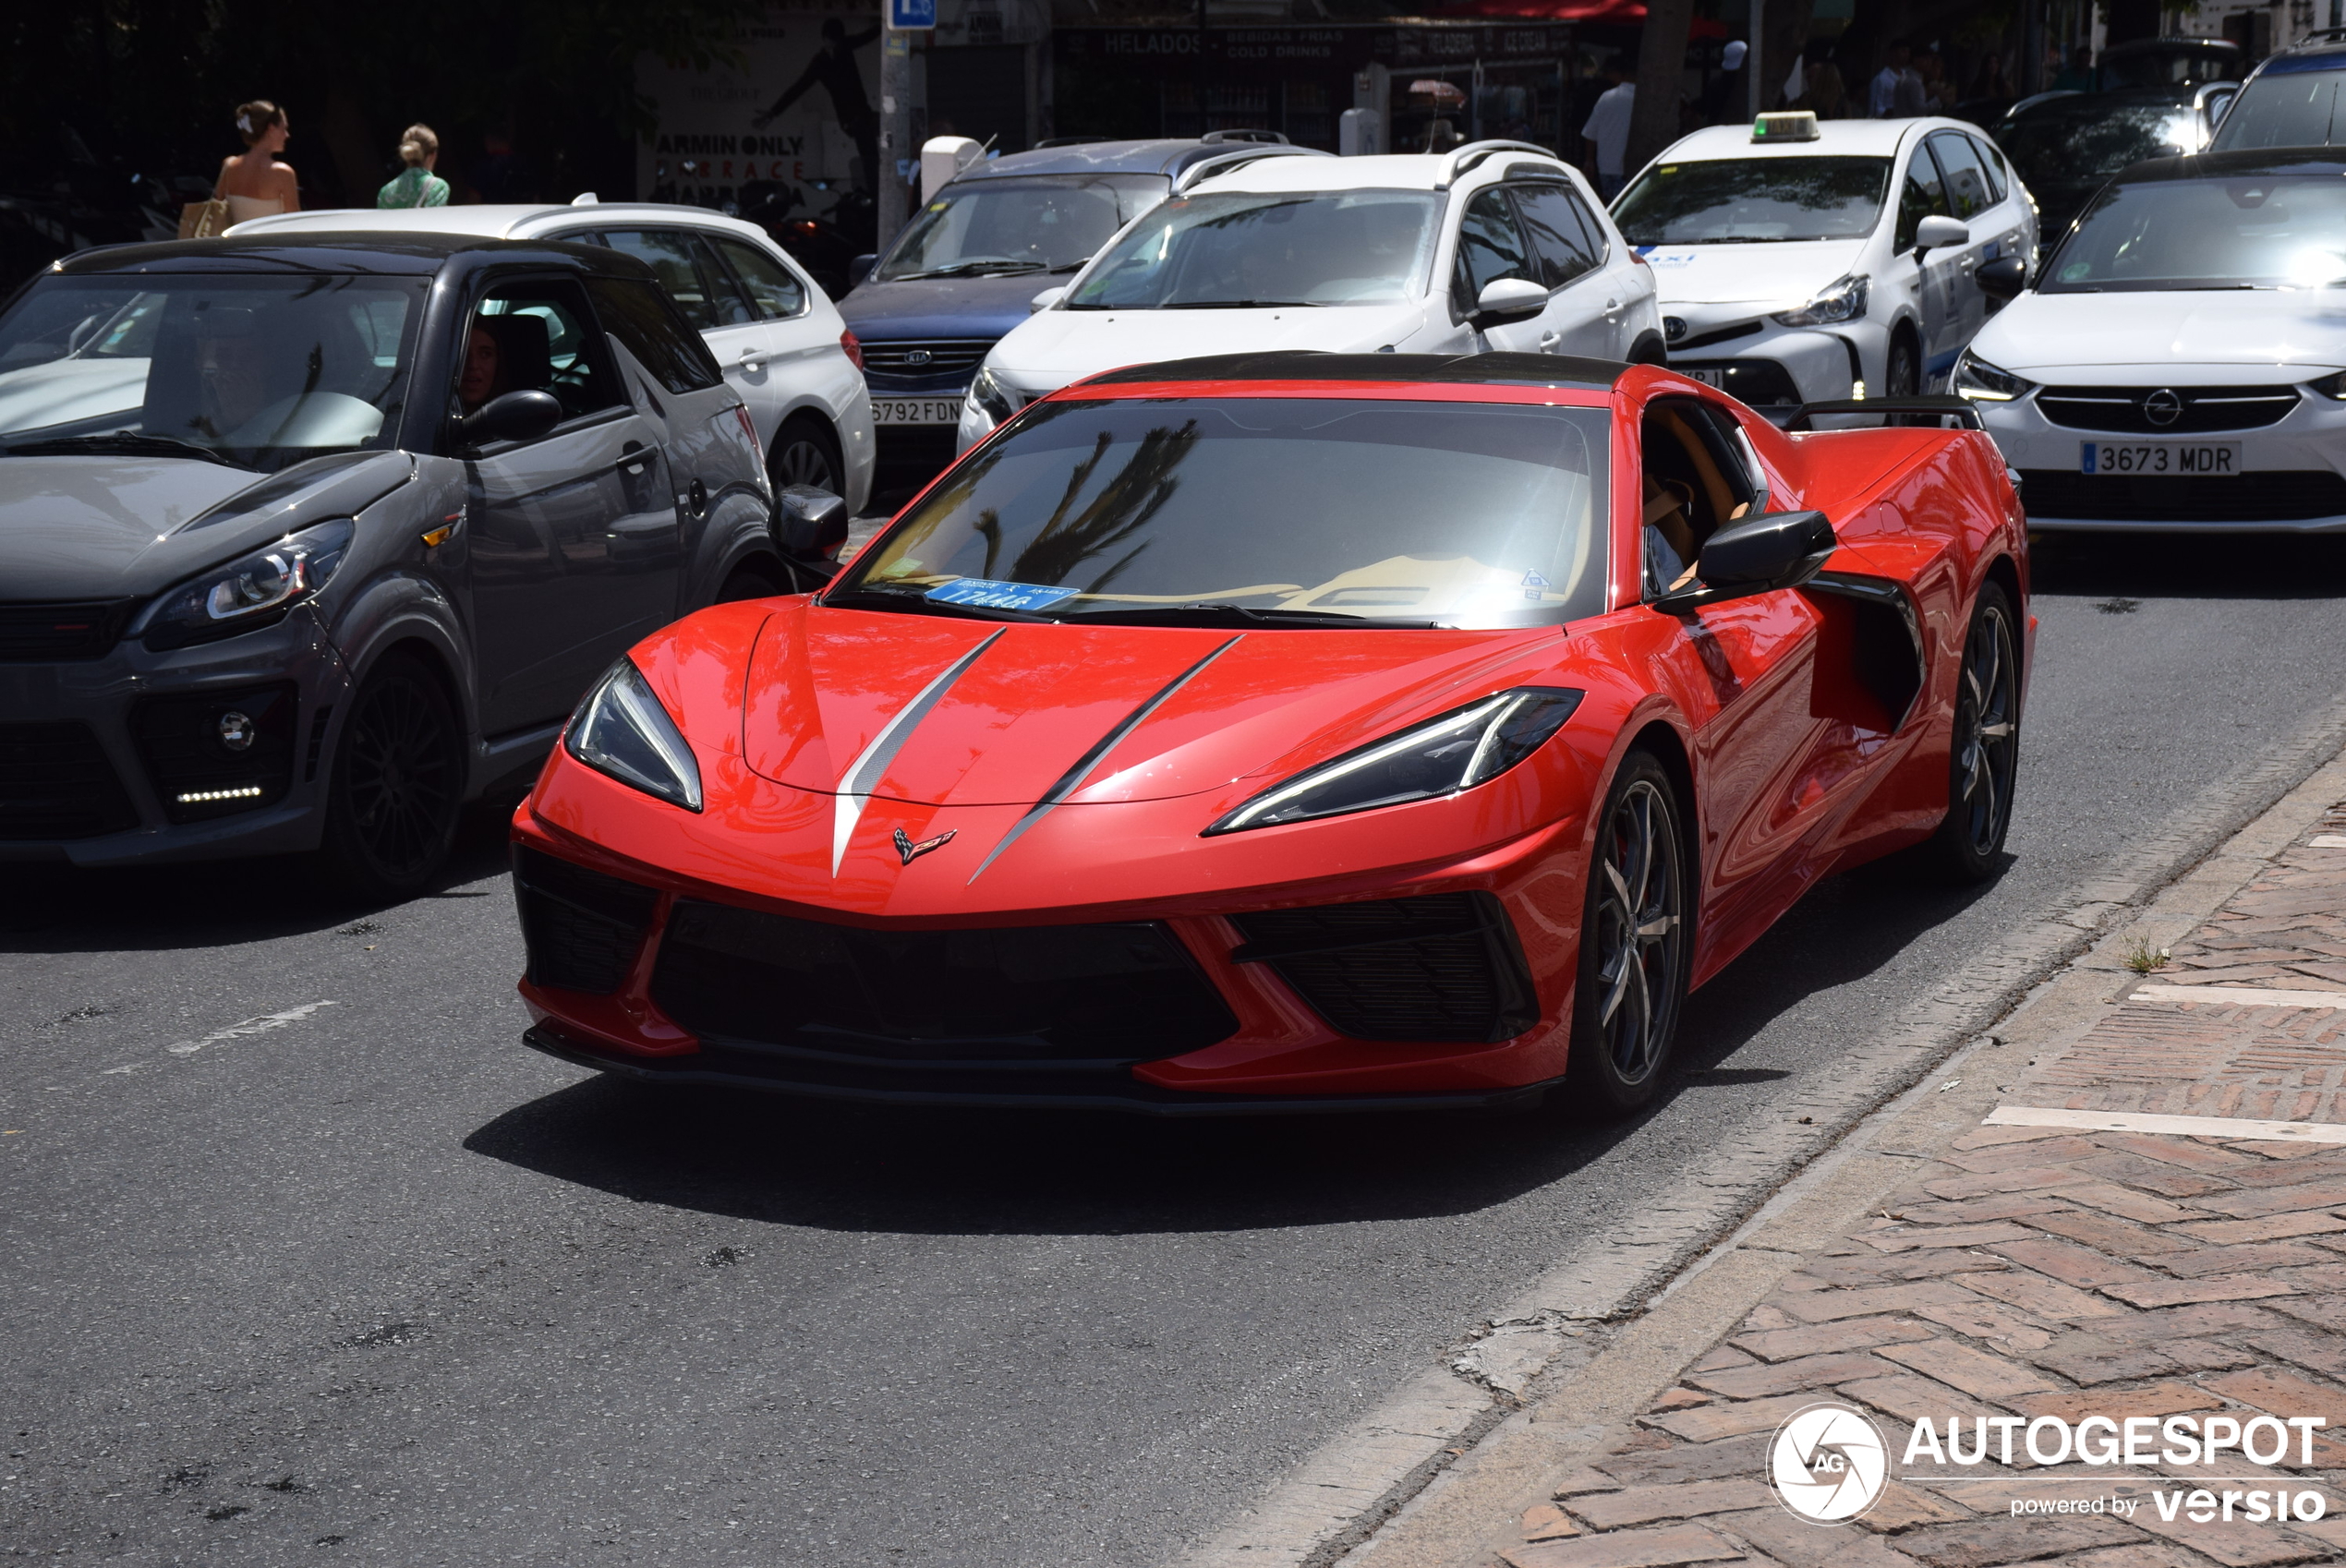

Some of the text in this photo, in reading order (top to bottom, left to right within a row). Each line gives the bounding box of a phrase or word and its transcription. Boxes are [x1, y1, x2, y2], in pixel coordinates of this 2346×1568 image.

[1104, 33, 1202, 54] HELADOS
[1227, 30, 1344, 42] BEBIDAS FRIAS
[1227, 45, 1332, 58] COLD DRINKS
[656, 135, 804, 156] ARMIN ONLY
[1645, 254, 1697, 262] axi
[908, 353, 927, 363] KIA
[872, 402, 961, 422] 6792 FDN
[2100, 447, 2169, 472] 3673
[2179, 447, 2232, 472] MDR
